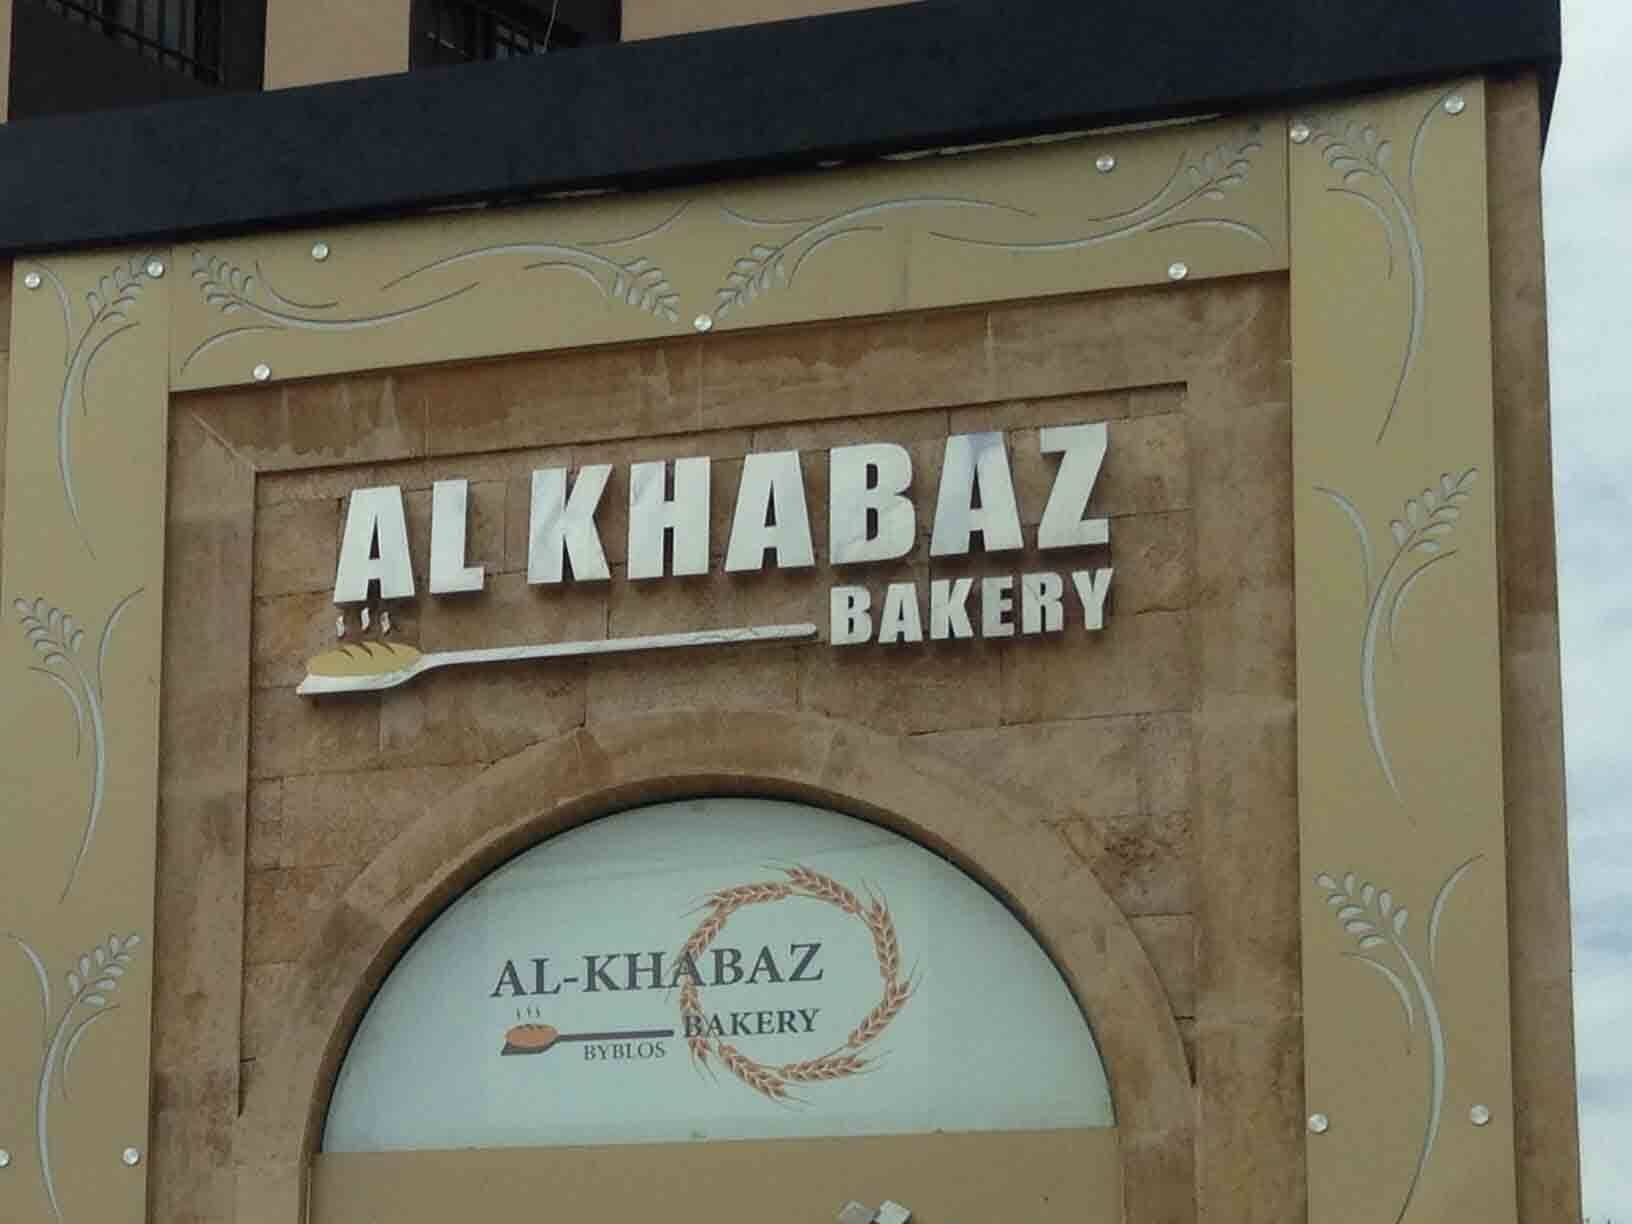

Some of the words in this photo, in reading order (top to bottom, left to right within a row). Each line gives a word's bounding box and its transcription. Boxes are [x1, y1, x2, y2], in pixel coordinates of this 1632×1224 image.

[333, 478, 485, 604] AL
[526, 422, 1111, 586] KHABAZ
[829, 567, 1114, 646] BAKERY
[489, 942, 825, 998] AL-KHABAZ
[683, 1007, 821, 1038] BAKERY
[584, 1042, 666, 1061] BYBLOS
